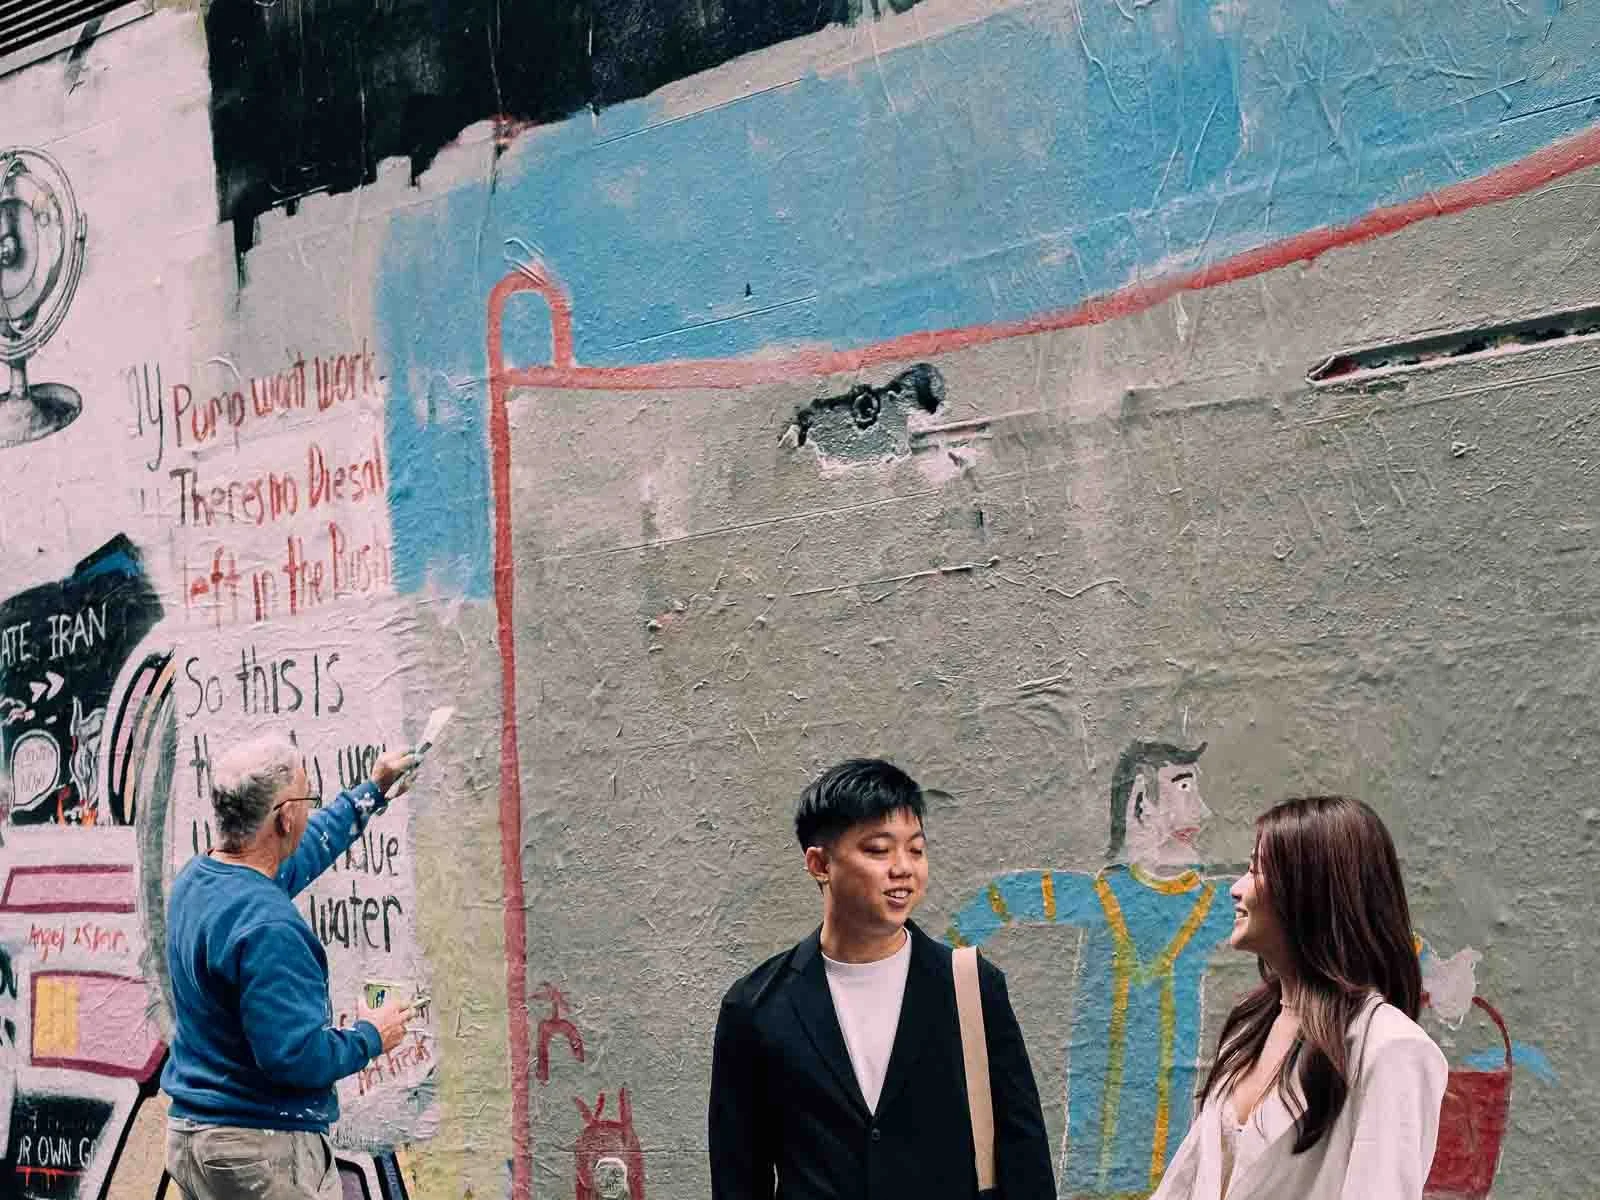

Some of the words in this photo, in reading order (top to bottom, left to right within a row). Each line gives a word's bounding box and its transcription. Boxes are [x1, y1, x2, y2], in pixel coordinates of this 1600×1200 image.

[47, 601, 107, 661] IRAN
[185, 656, 223, 719] So
[37, 1135, 72, 1167] OWN
